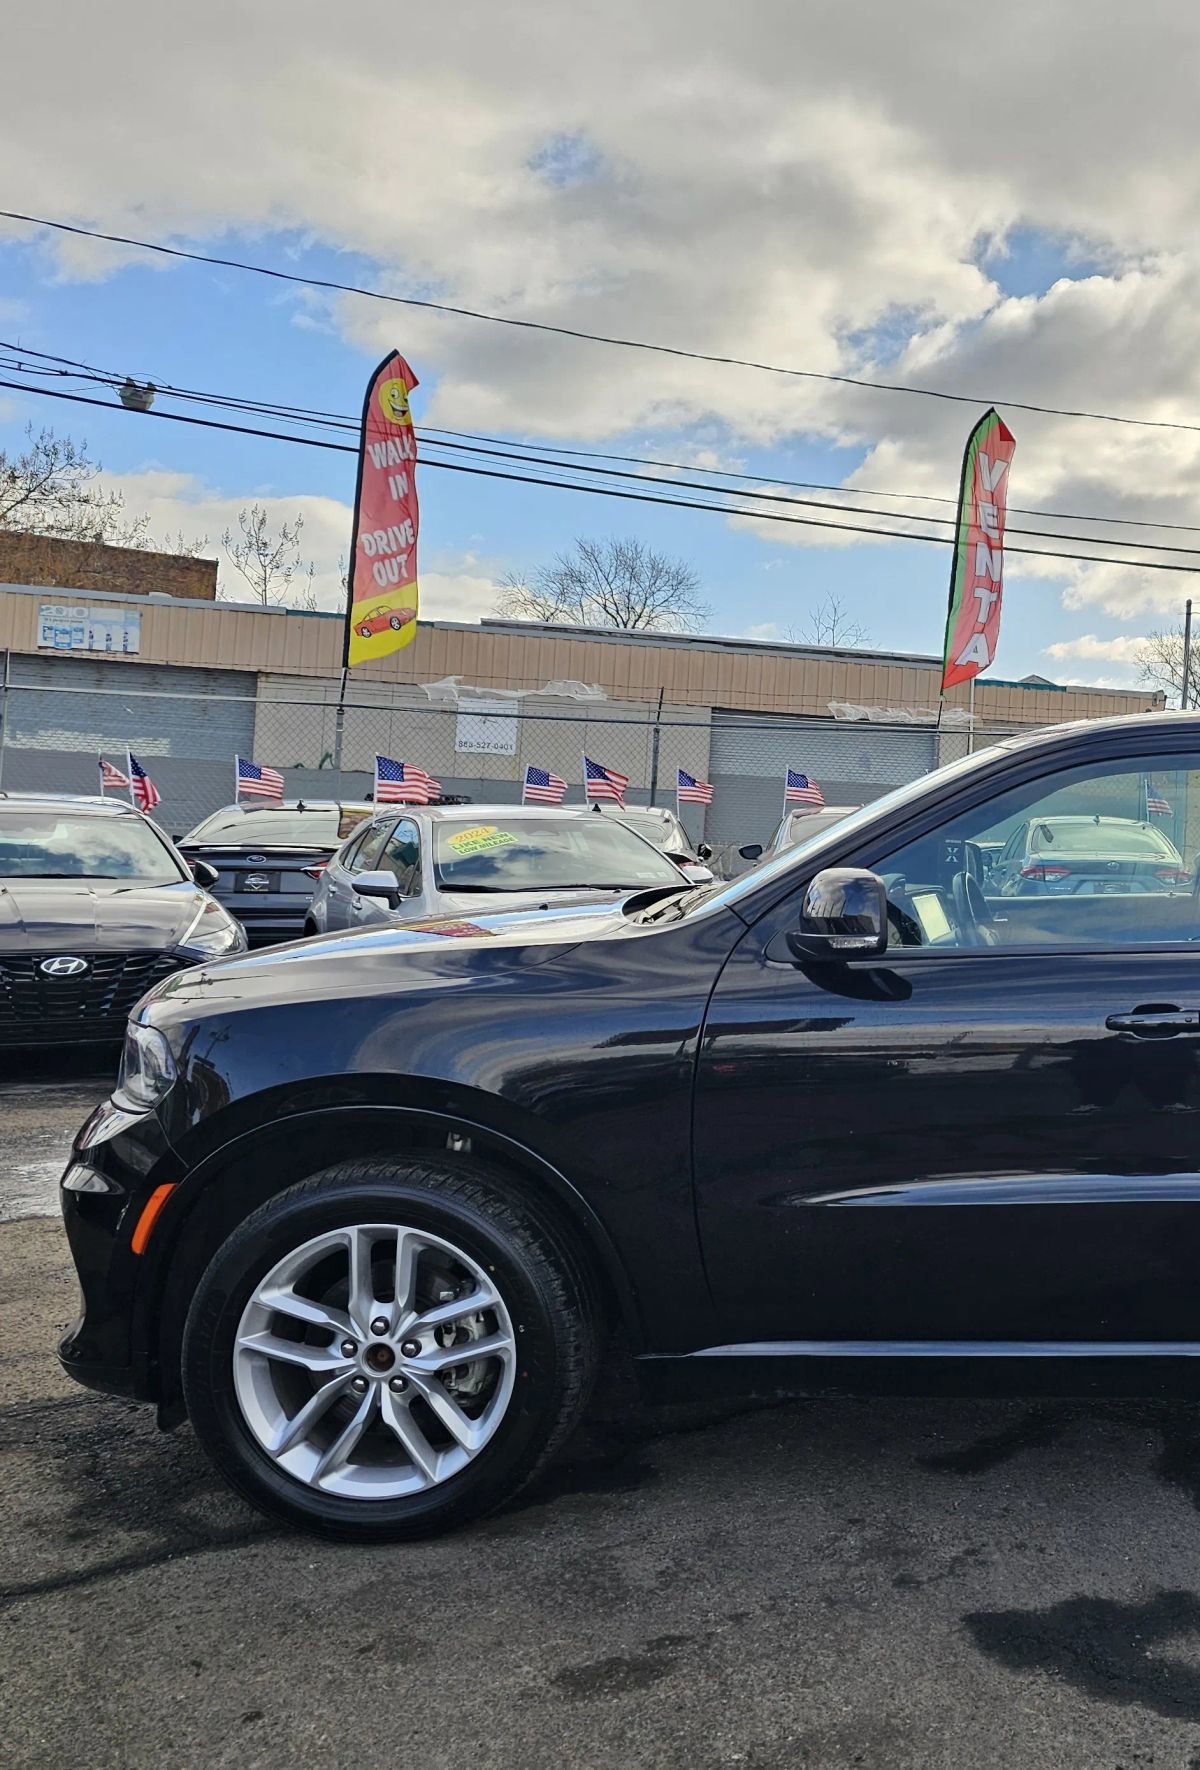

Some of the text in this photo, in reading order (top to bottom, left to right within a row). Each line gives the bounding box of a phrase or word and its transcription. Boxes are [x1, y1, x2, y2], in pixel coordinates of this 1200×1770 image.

[368, 434, 414, 470] WALK
[388, 471, 408, 500] IN
[361, 518, 414, 557] DRIVE
[373, 555, 408, 587] OUT
[954, 452, 1009, 668] VENTA
[452, 832, 509, 850] LIKE NEW
[455, 827, 489, 843] 2024
[459, 836, 514, 855] LOW MILEAGE
